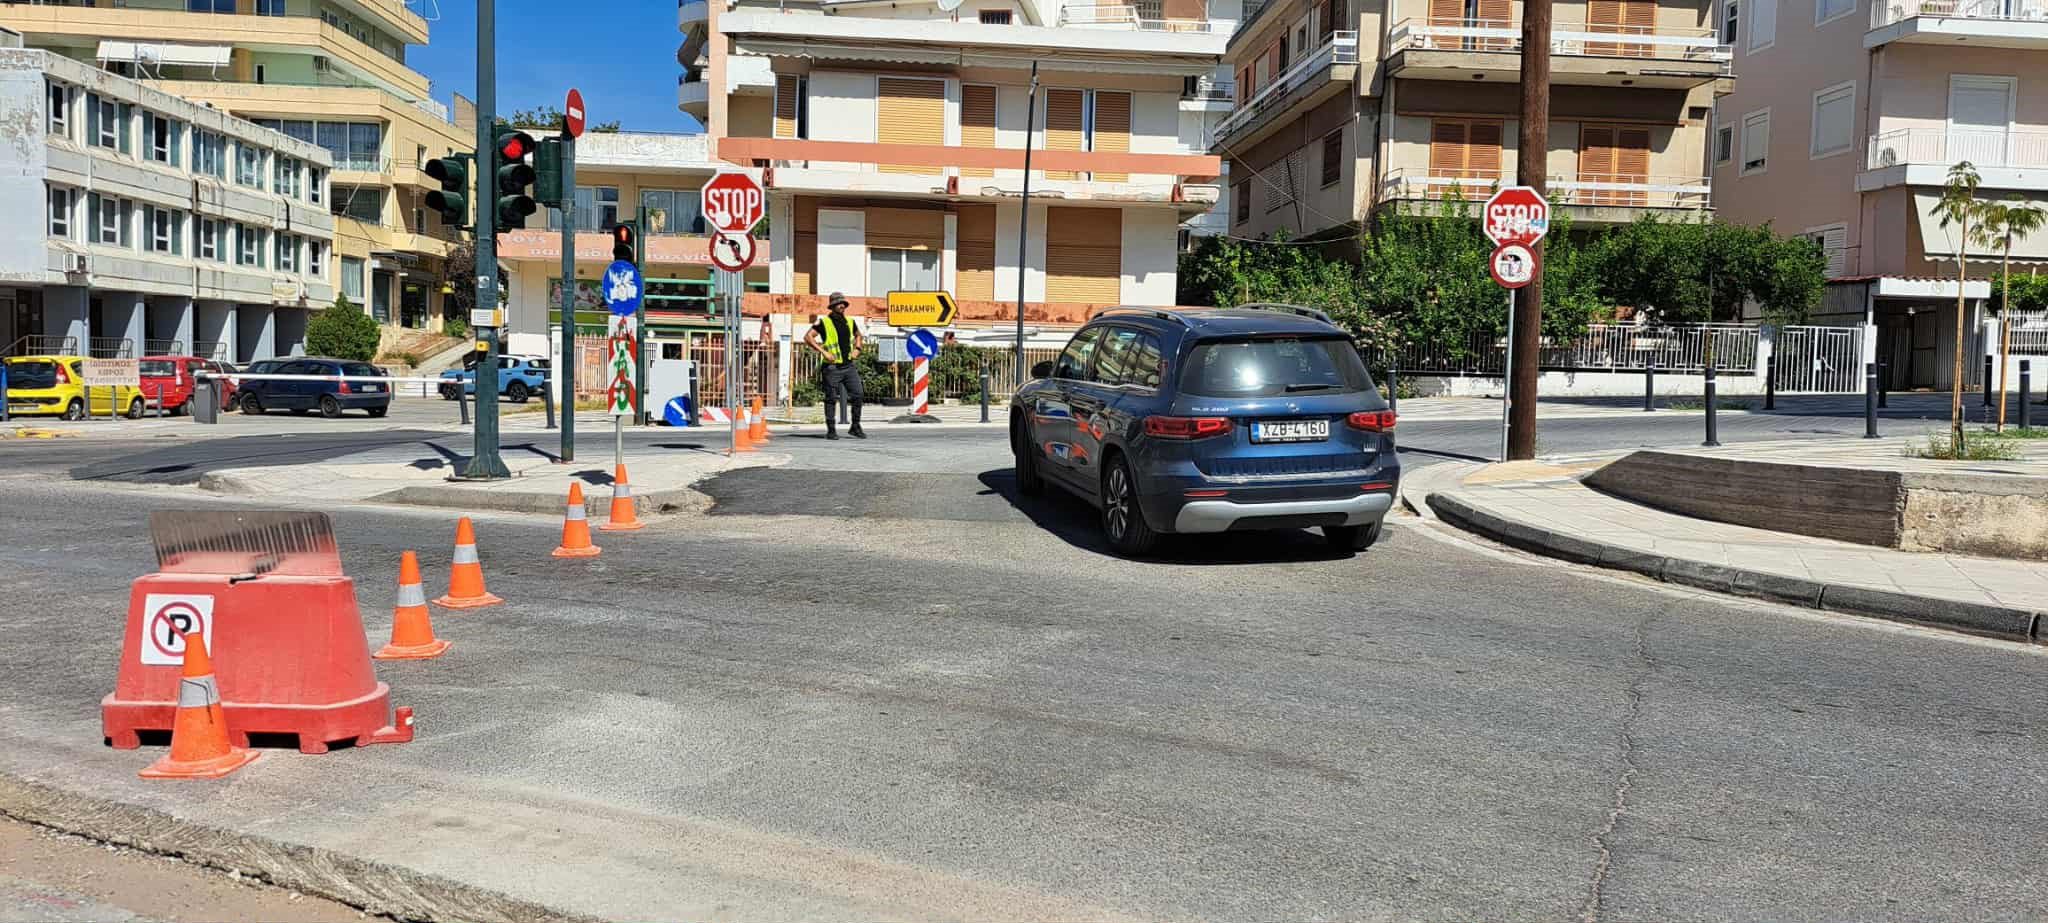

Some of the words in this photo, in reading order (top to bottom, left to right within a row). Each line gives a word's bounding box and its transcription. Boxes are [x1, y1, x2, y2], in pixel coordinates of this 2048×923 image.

[707, 187, 760, 219] STOP
[1489, 203, 1544, 236] STOP
[890, 304, 936, 313] ΠΑΡΑΚΑΜΨΗ
